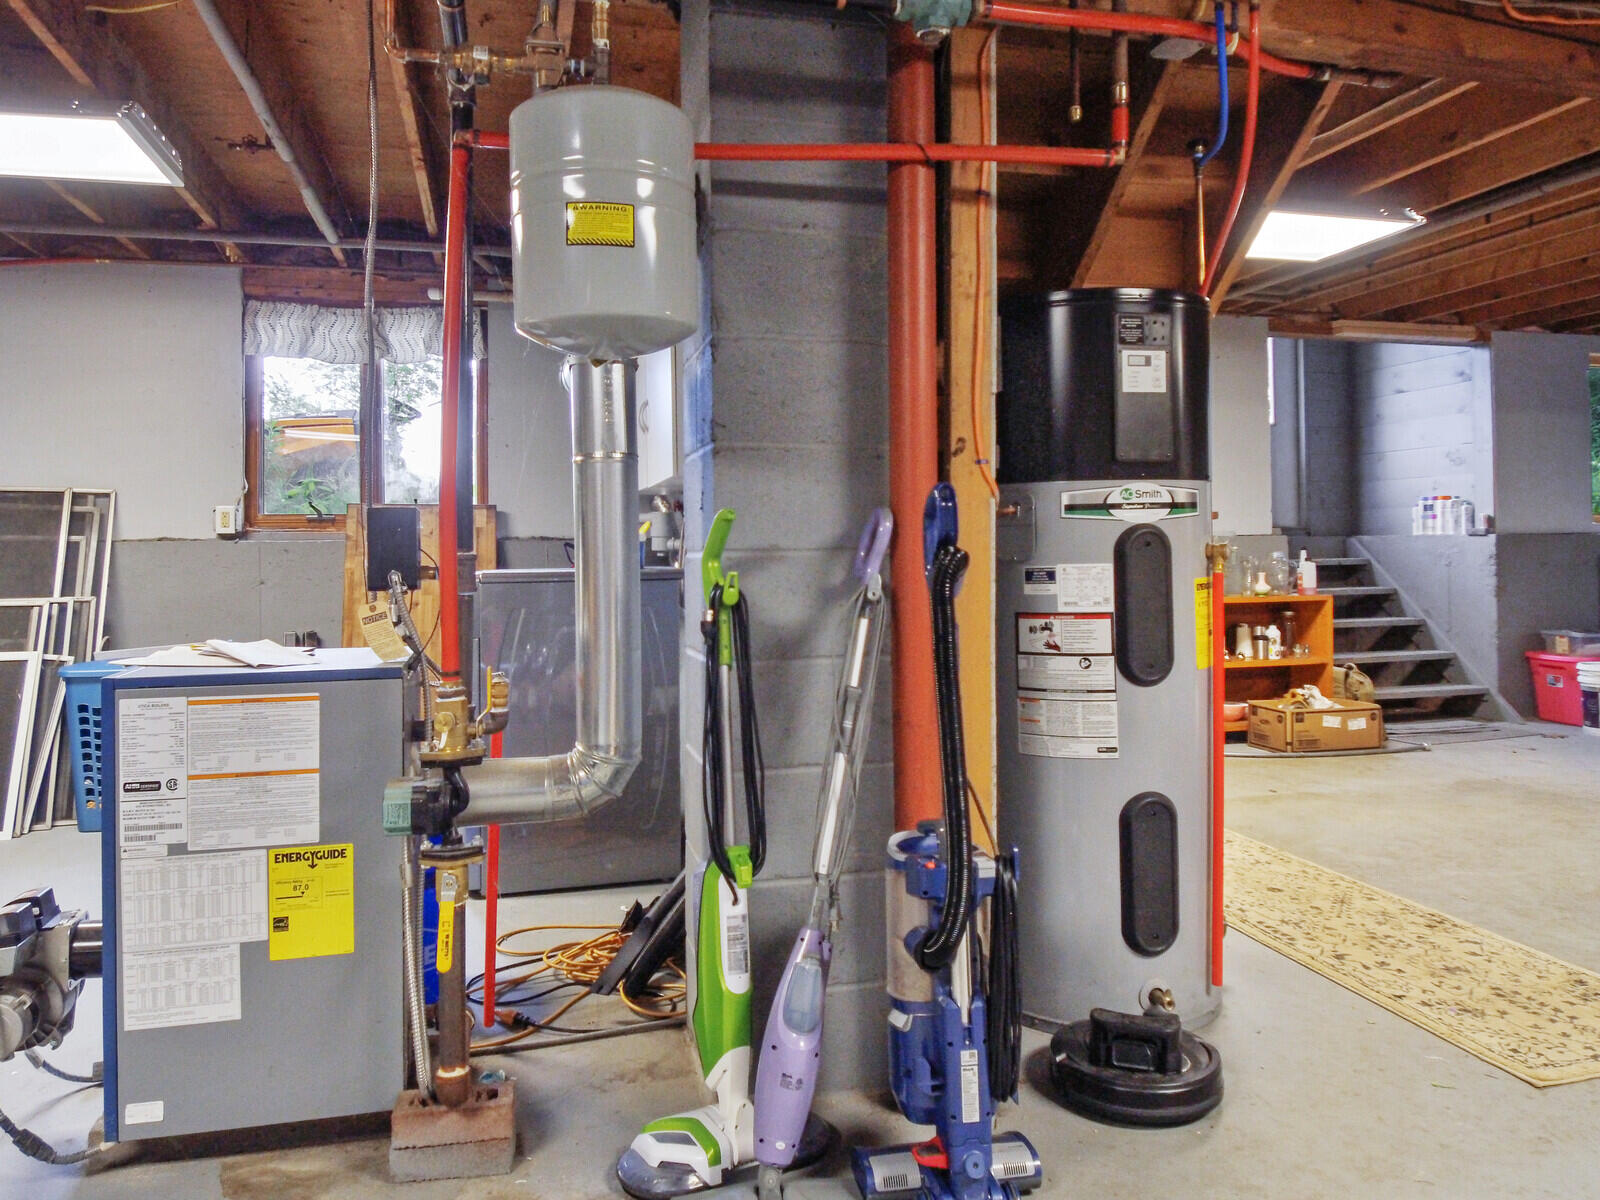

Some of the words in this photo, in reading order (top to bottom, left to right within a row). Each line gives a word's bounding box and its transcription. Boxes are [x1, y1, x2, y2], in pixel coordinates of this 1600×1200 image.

[580, 204, 627, 212] WARNING
[1135, 489, 1162, 498] Smith
[363, 612, 387, 624] NOTICE
[274, 848, 347, 866] ENERGYGUIDE
